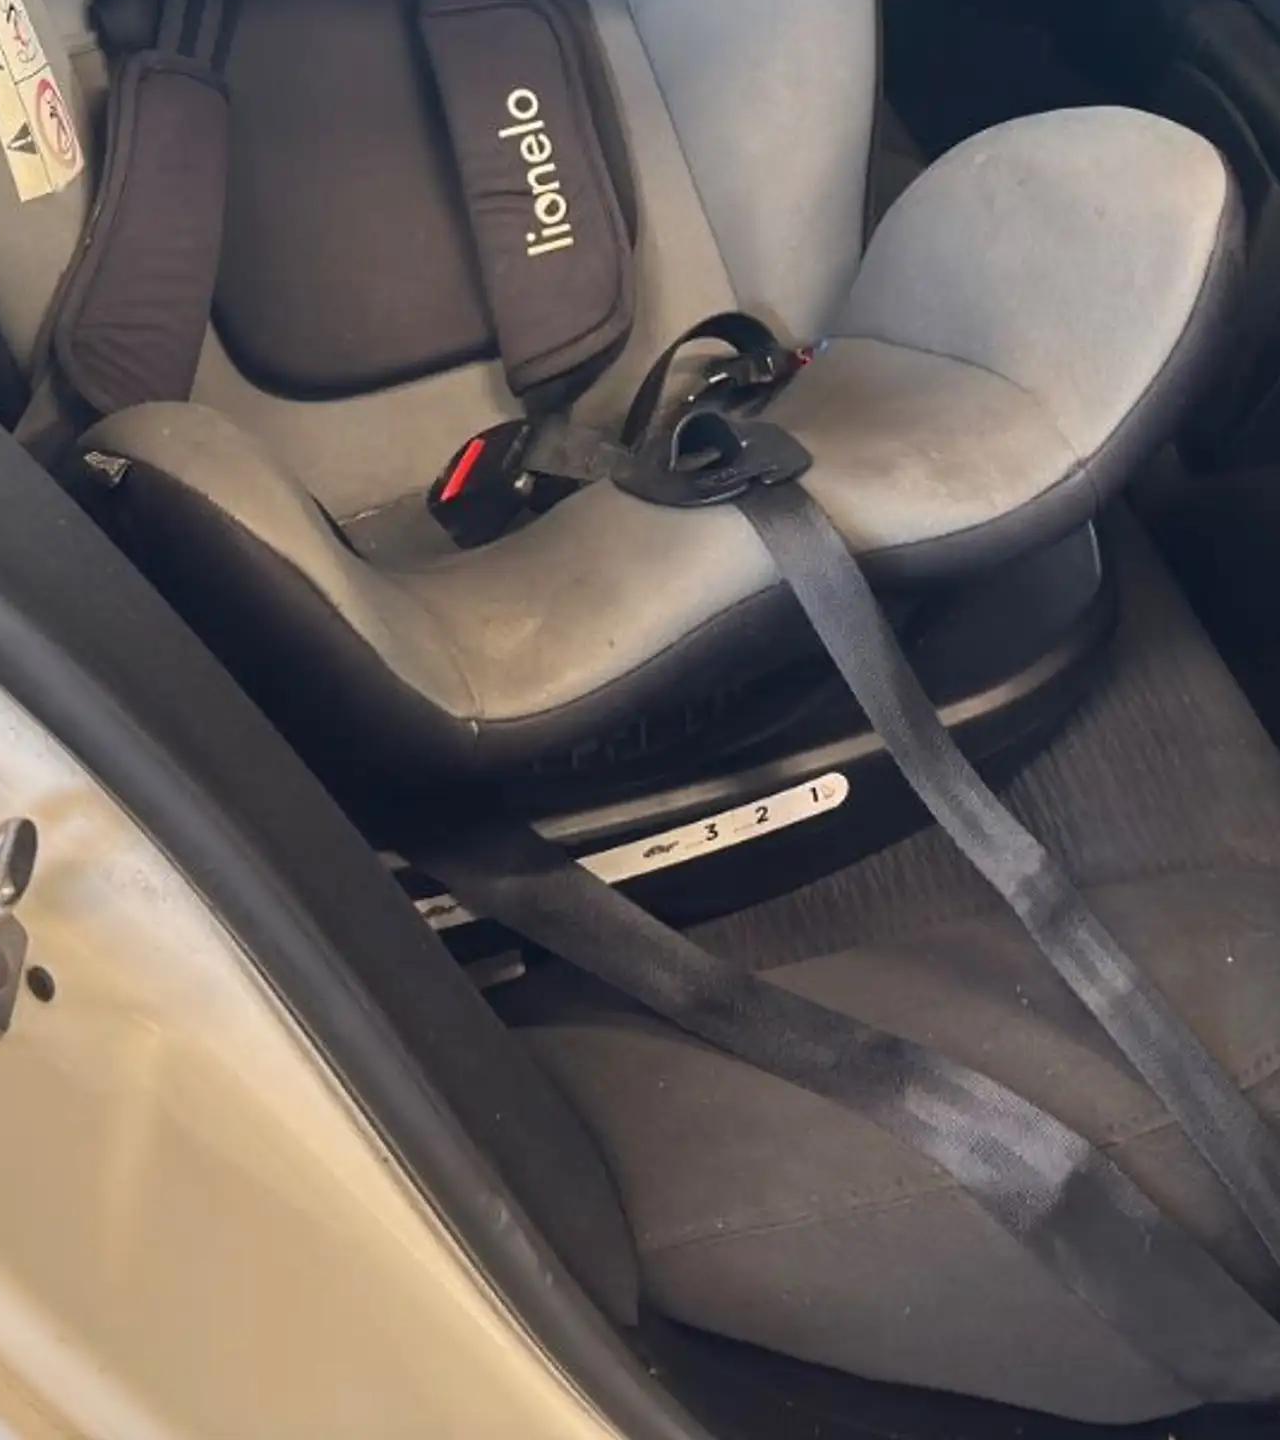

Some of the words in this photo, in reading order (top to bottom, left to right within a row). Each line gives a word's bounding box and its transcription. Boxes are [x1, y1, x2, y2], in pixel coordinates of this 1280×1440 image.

[498, 88, 574, 256] lionelo
[704, 823, 719, 841] 3
[755, 806, 770, 824] 2
[810, 786, 819, 803] 1
